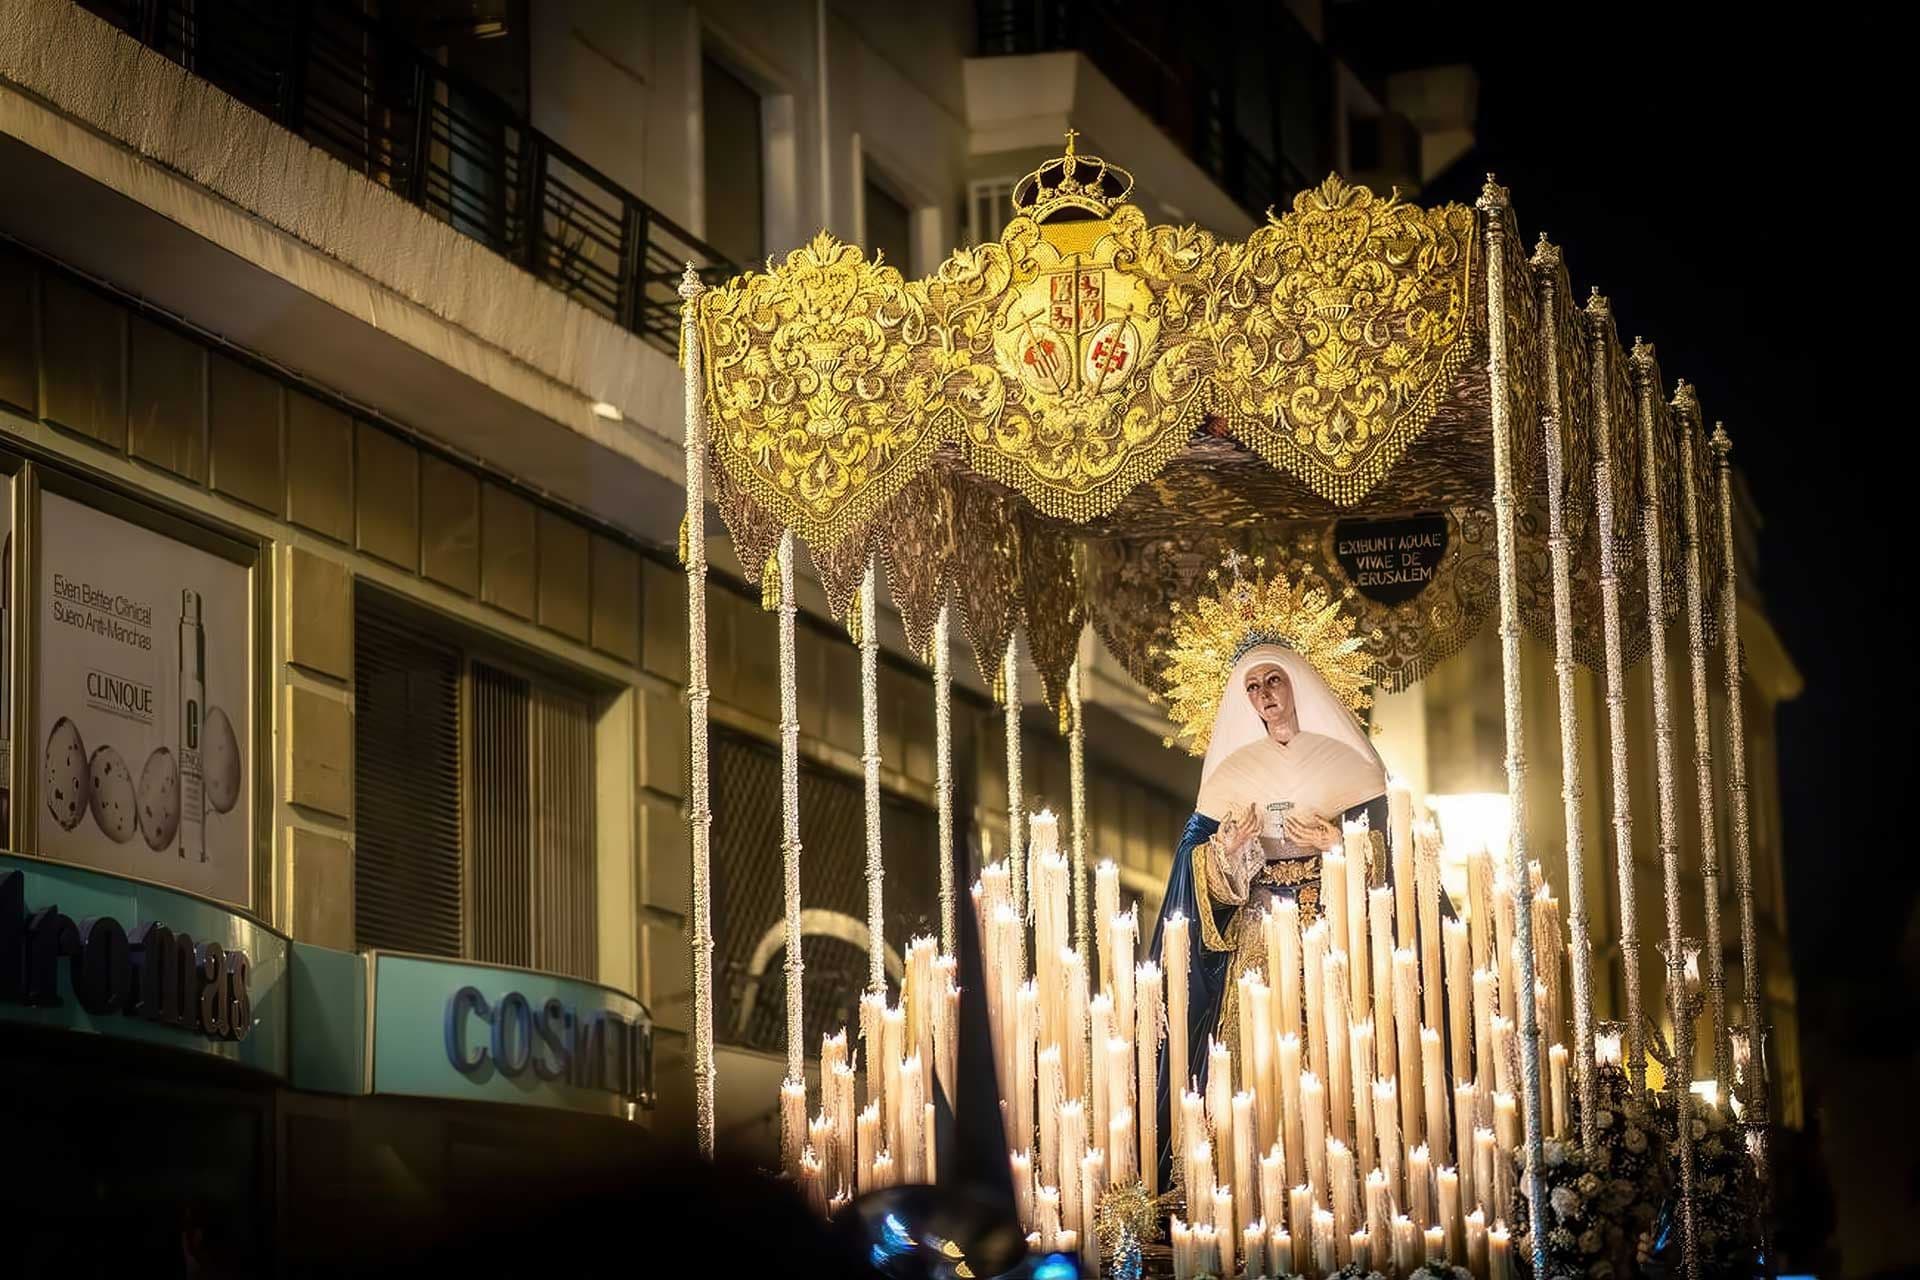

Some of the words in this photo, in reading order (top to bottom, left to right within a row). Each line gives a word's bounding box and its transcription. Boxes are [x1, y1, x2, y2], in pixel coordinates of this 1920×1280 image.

[1339, 537, 1395, 555] EXIBUNT
[1399, 533, 1441, 551] AQUAE
[1356, 555, 1394, 569] VIVAE
[1401, 552, 1421, 567] DE
[1352, 566, 1432, 587] JERUSALEM
[53, 573, 81, 600] Even
[82, 583, 114, 611] Better
[115, 595, 152, 625] Clinical
[53, 601, 84, 629] Suero
[86, 672, 152, 714] CLINIQUE
